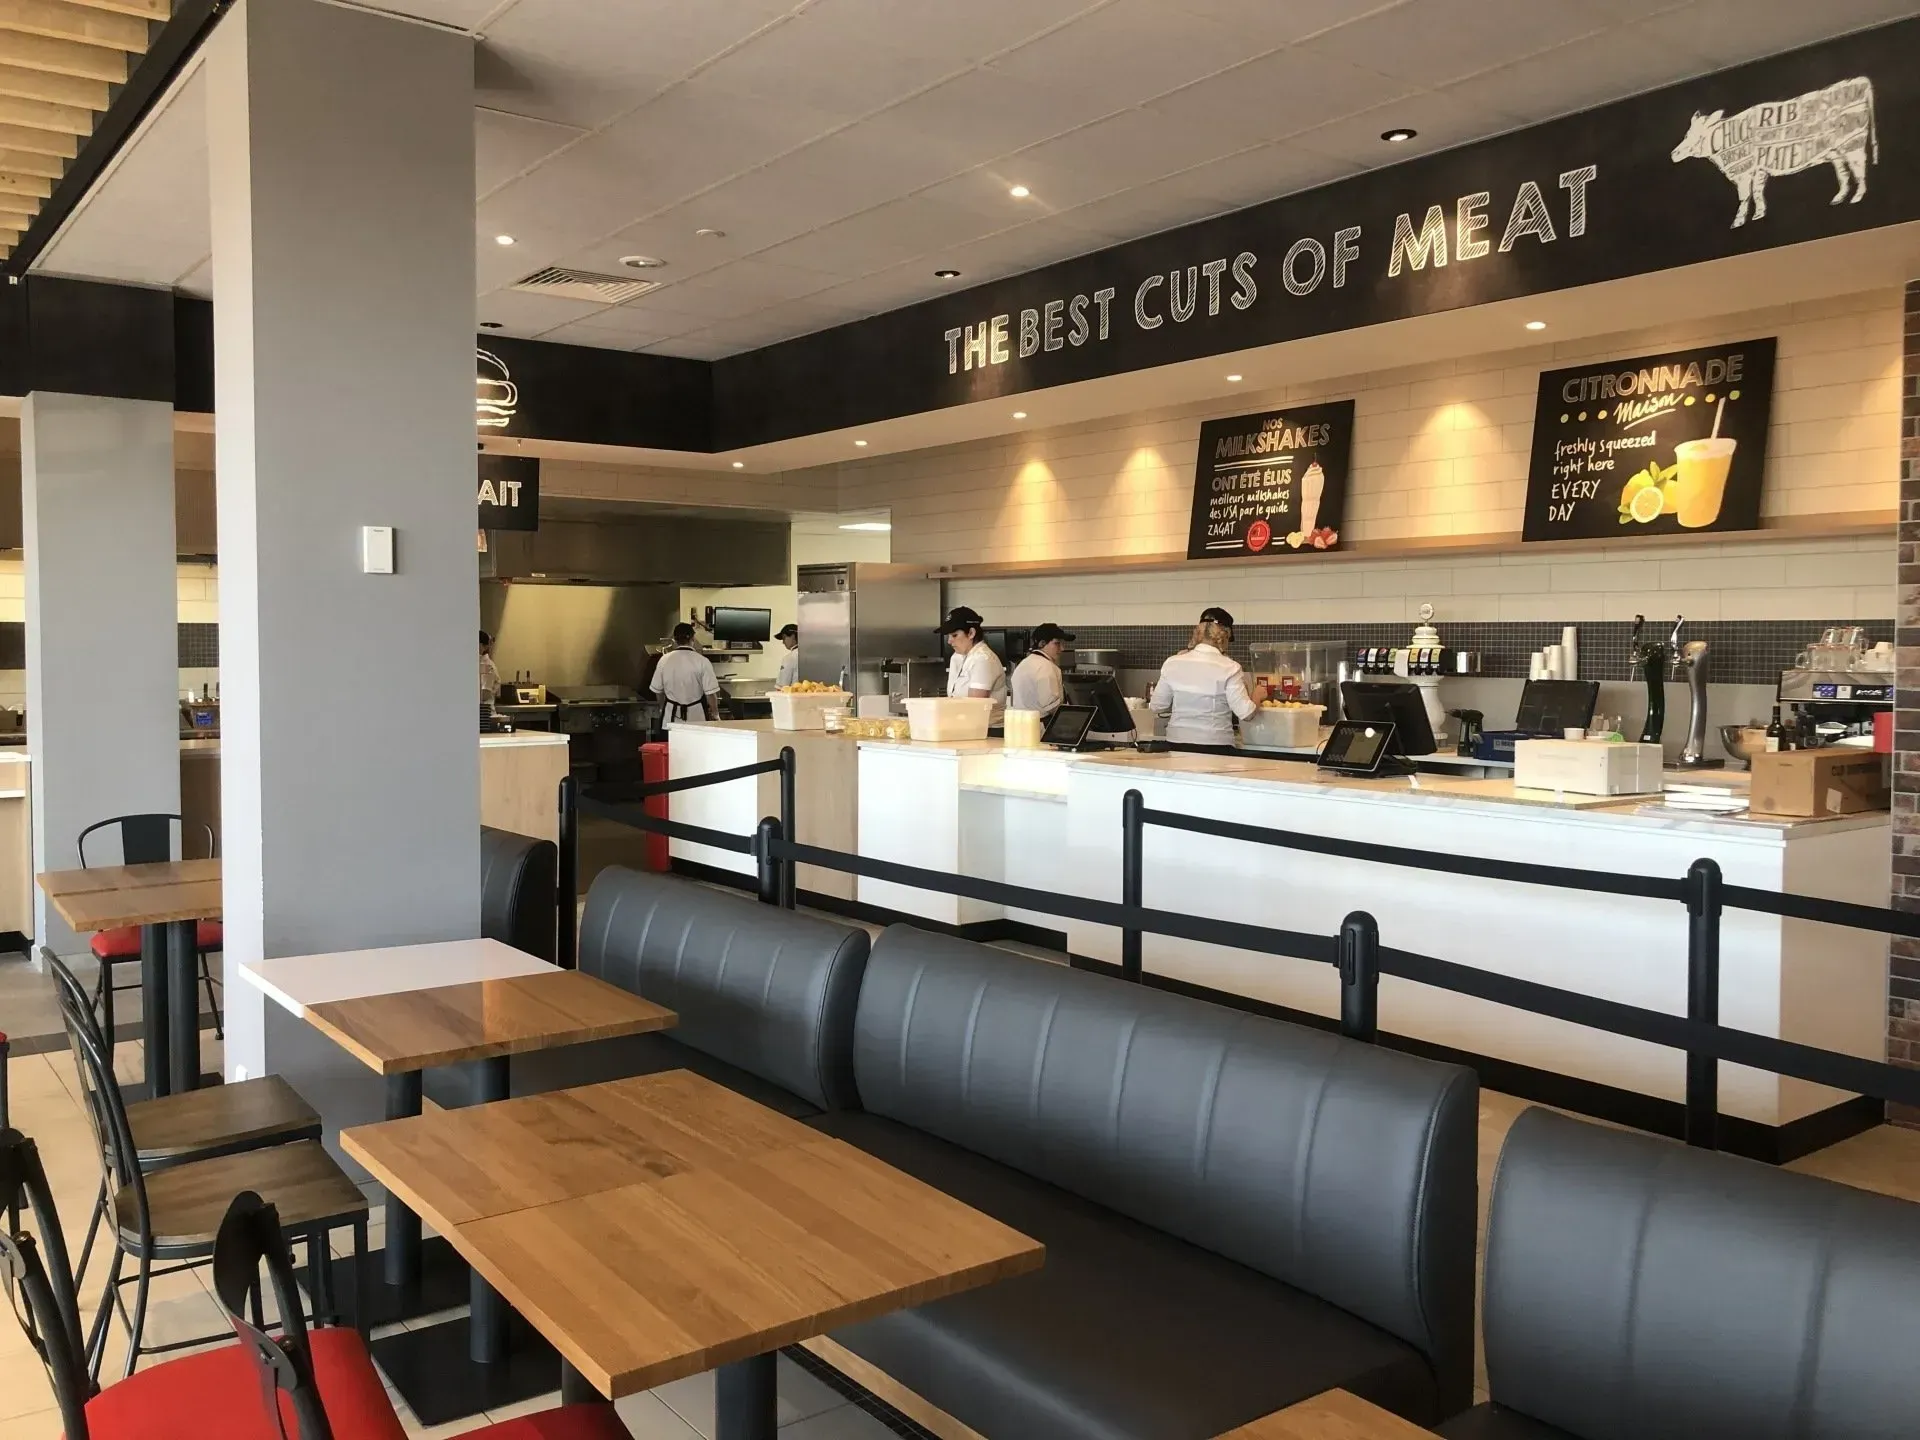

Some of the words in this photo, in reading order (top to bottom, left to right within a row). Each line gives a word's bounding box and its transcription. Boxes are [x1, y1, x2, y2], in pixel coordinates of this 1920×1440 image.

[1760, 102, 1798, 127] RIB
[944, 313, 1010, 374] THE
[1019, 287, 1116, 359] BEST
[1134, 252, 1259, 330] CUTS
[1282, 226, 1362, 296] OF
[1388, 165, 1598, 277] MEAT
[1562, 354, 1745, 404] CITRONNADE
[1613, 392, 1685, 424] Maison
[1263, 418, 1283, 431] NOS
[1216, 423, 1331, 458] MILKSHAKES
[1554, 437, 1596, 461] freshly
[1599, 430, 1657, 457] squeezed
[1212, 474, 1238, 492] ONT
[1240, 470, 1261, 490] ÉTÉ
[1263, 468, 1293, 487] ÉLUS
[1553, 458, 1584, 480] right
[1587, 456, 1615, 473] here
[478, 479, 522, 507] AIT
[1210, 492, 1245, 506] meilleurs
[1247, 487, 1290, 503] milkshakes
[1551, 479, 1601, 500] EVERY
[1210, 507, 1221, 519] des
[1223, 505, 1238, 519] USA
[1239, 503, 1255, 521] par
[1256, 503, 1264, 516] le
[1266, 502, 1288, 519] guide
[1548, 501, 1576, 523] DAY
[1208, 521, 1236, 536] ZAGAT
